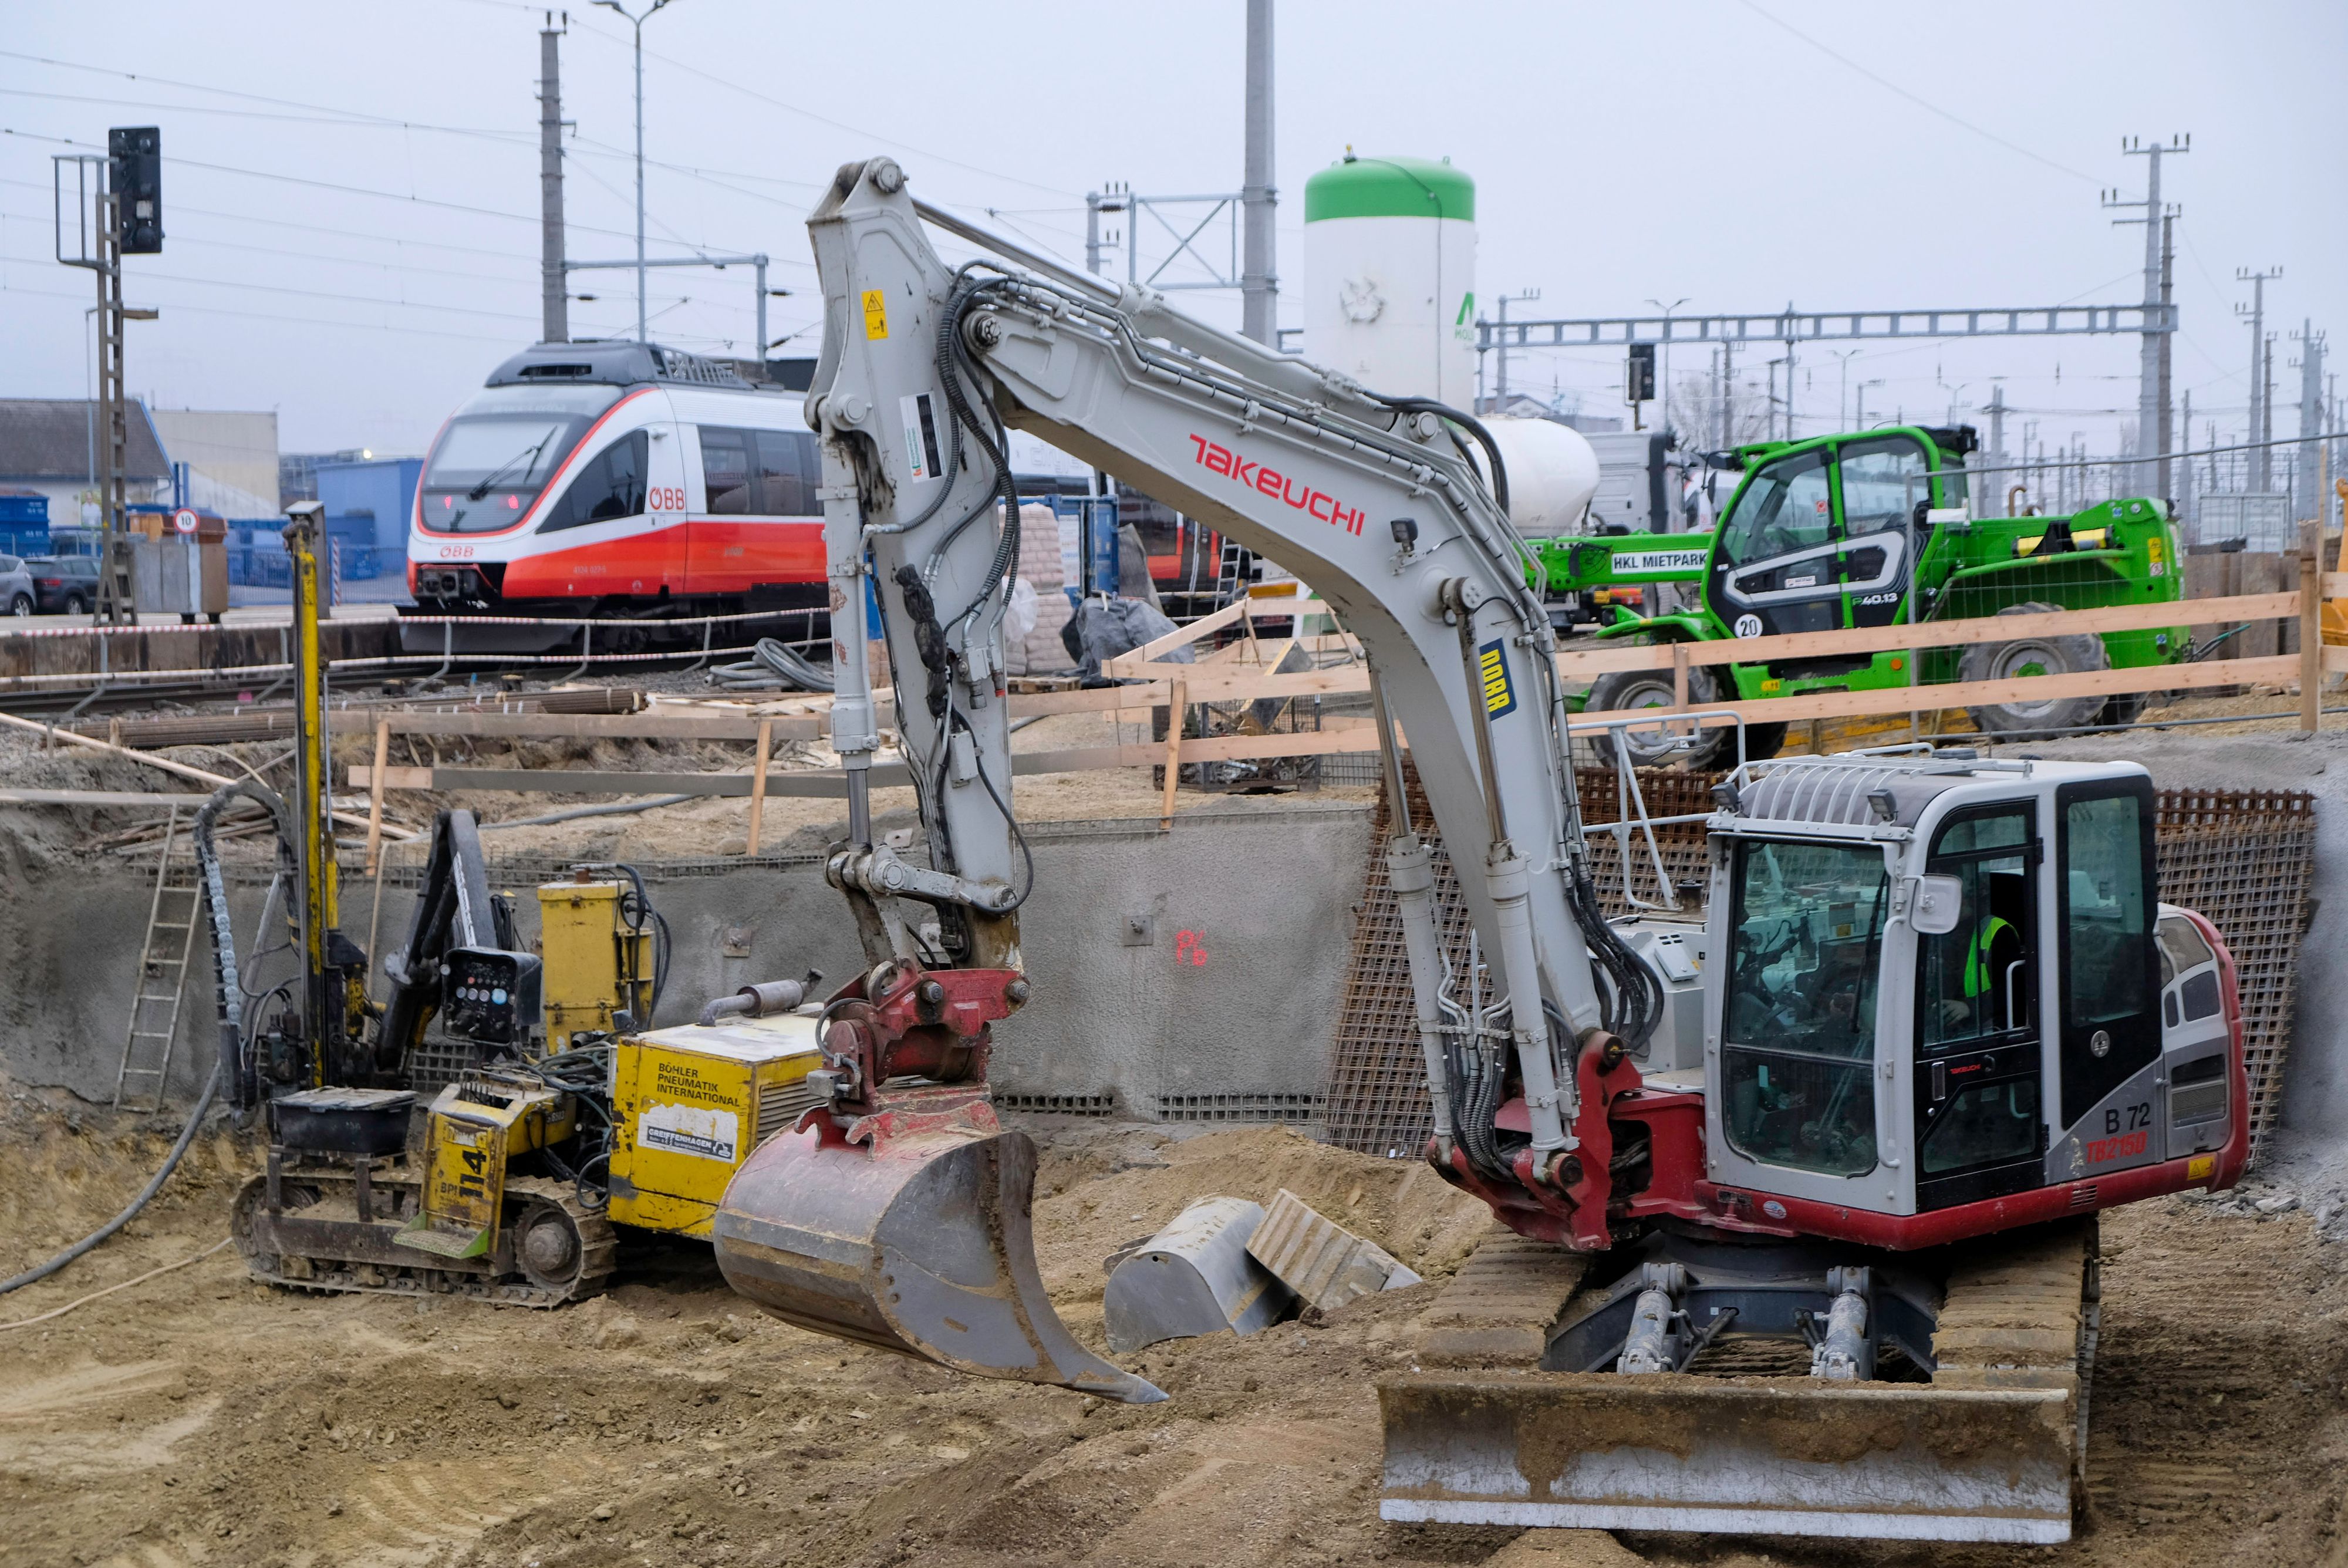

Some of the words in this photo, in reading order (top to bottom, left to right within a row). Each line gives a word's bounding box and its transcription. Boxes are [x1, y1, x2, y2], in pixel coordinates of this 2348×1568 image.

[649, 487, 685, 510] ÖBB
[181, 515, 191, 526] 10
[440, 545, 474, 558] ÖBB
[1614, 556, 1638, 569] HKL
[1643, 553, 1707, 568] MIETPARK
[1740, 619, 1757, 636] 20
[657, 1074, 718, 1092] PNEUMATIK
[657, 1084, 740, 1107] INTERNATIONAL
[2106, 1109, 2120, 1134] B
[2127, 1102, 2150, 1131] 72
[648, 1128, 712, 1148] GREIFFENHAGEN
[2086, 1131, 2147, 1164] TB2150
